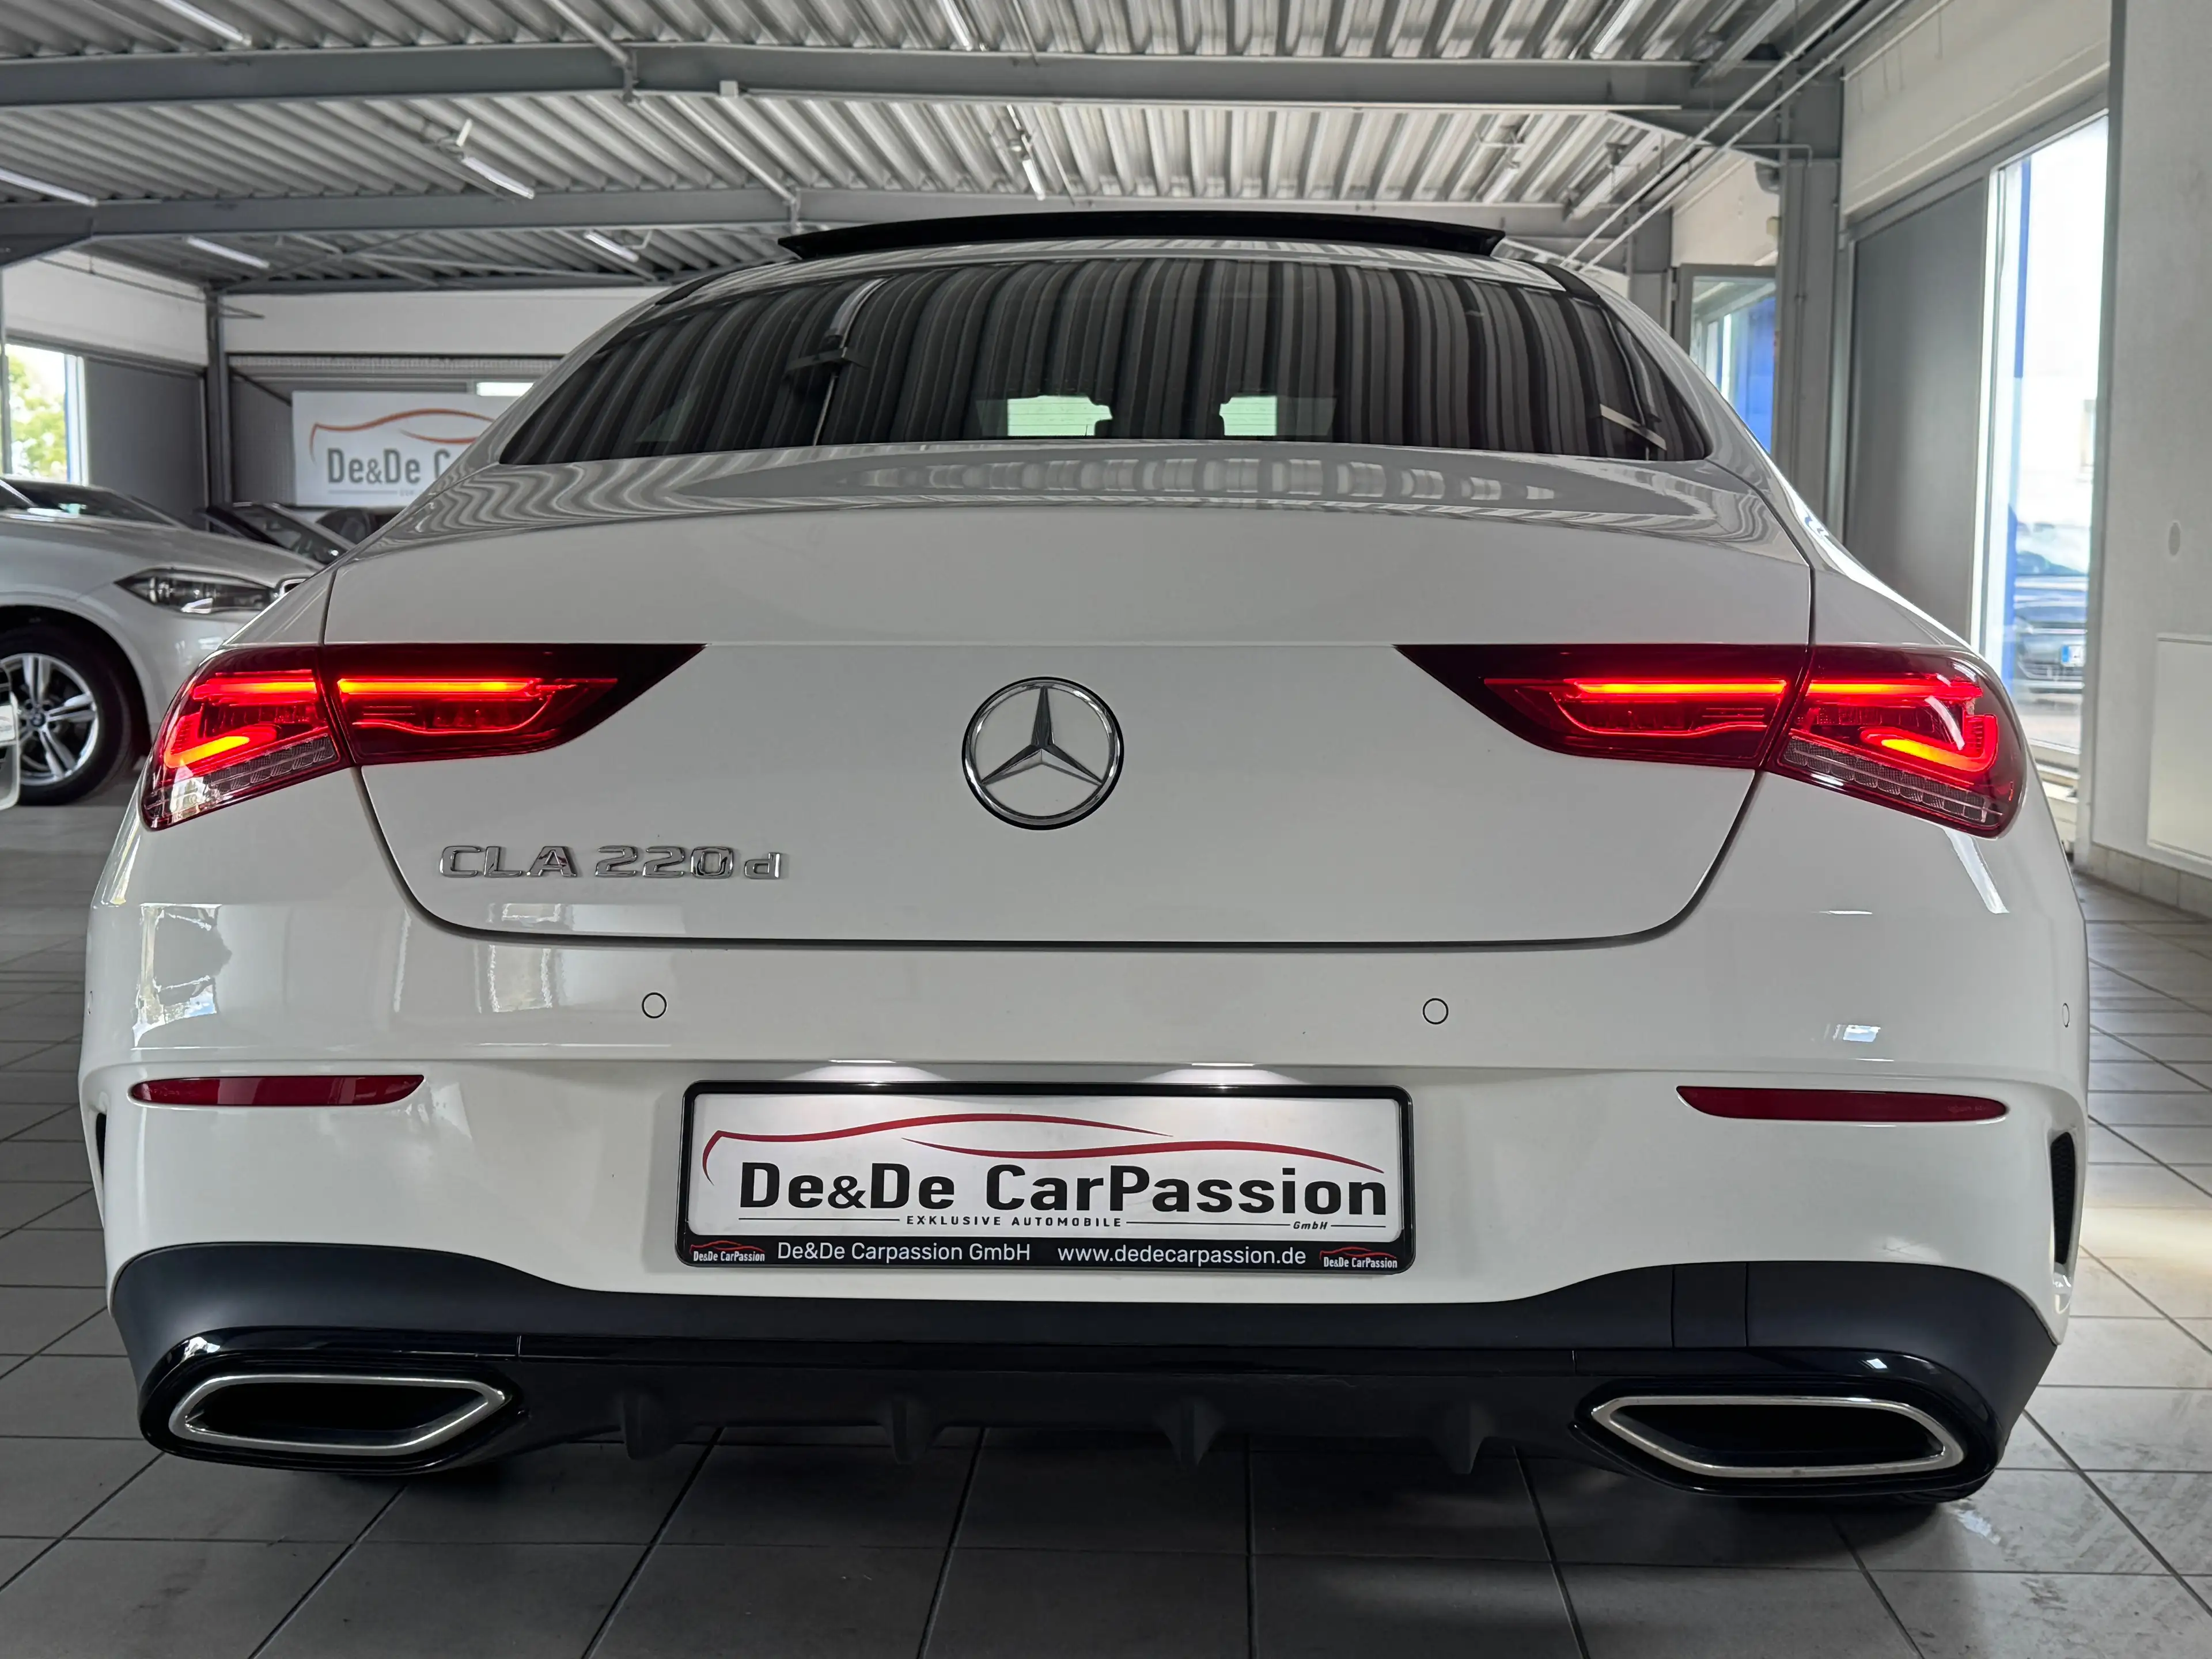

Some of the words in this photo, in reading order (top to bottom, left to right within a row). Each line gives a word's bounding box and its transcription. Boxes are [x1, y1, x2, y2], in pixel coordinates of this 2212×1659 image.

[327, 447, 421, 484] De&De
[440, 845, 577, 878] CLA
[595, 845, 734, 879] 220
[744, 851, 782, 879] d
[740, 1162, 955, 1210] De&De
[986, 1164, 1387, 1215] CarPassion
[906, 1215, 1001, 1226] EXKLUSIVE
[1011, 1217, 1121, 1227] AUTOMOBILE
[1293, 1221, 1328, 1230] GmbH
[693, 1251, 718, 1262] De&De
[720, 1251, 766, 1262] CarPassion
[778, 1242, 846, 1260] De&De
[851, 1243, 963, 1264] Carpassion
[968, 1243, 1031, 1261] GmbH
[1058, 1244, 1306, 1267] www.dedecarpassion.de
[1323, 1256, 1350, 1267] De&De
[1351, 1257, 1398, 1268] CarPassion
